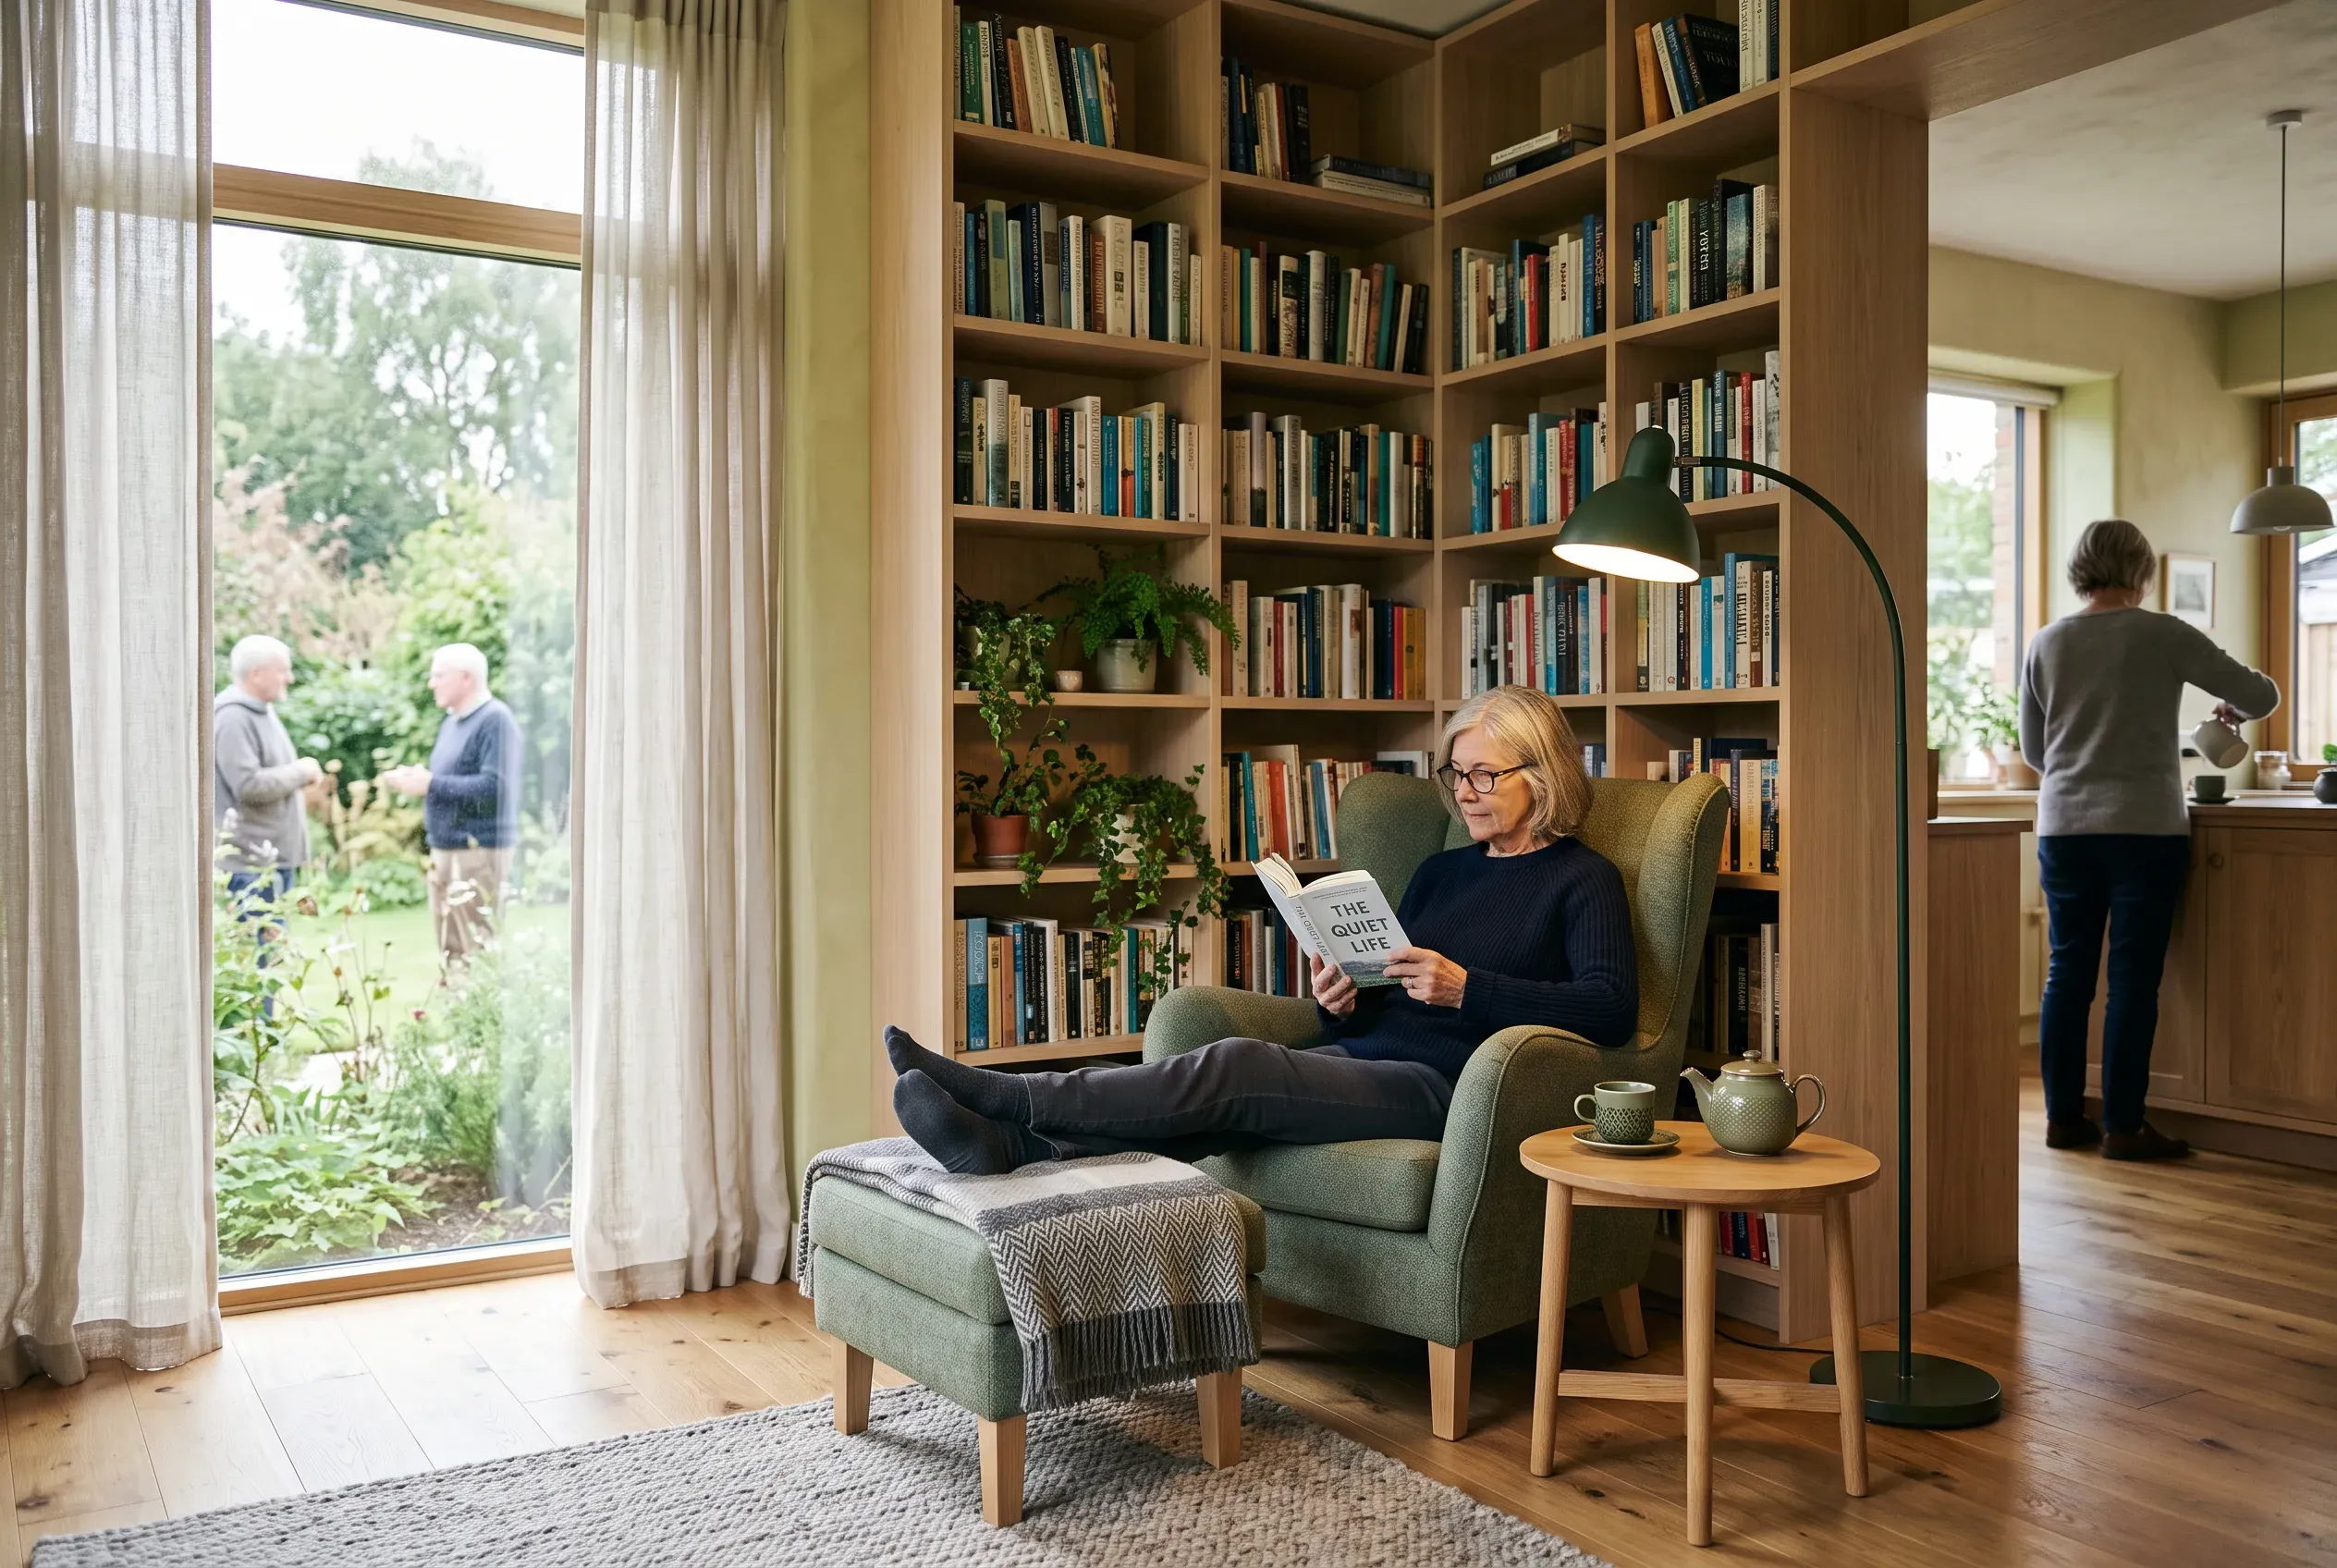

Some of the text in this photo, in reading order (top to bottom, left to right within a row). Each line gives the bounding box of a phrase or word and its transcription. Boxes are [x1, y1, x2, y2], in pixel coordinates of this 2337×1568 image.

[1330, 900, 1370, 917] THE
[1331, 918, 1389, 937] QUIET
[1351, 937, 1390, 953] LIFE
